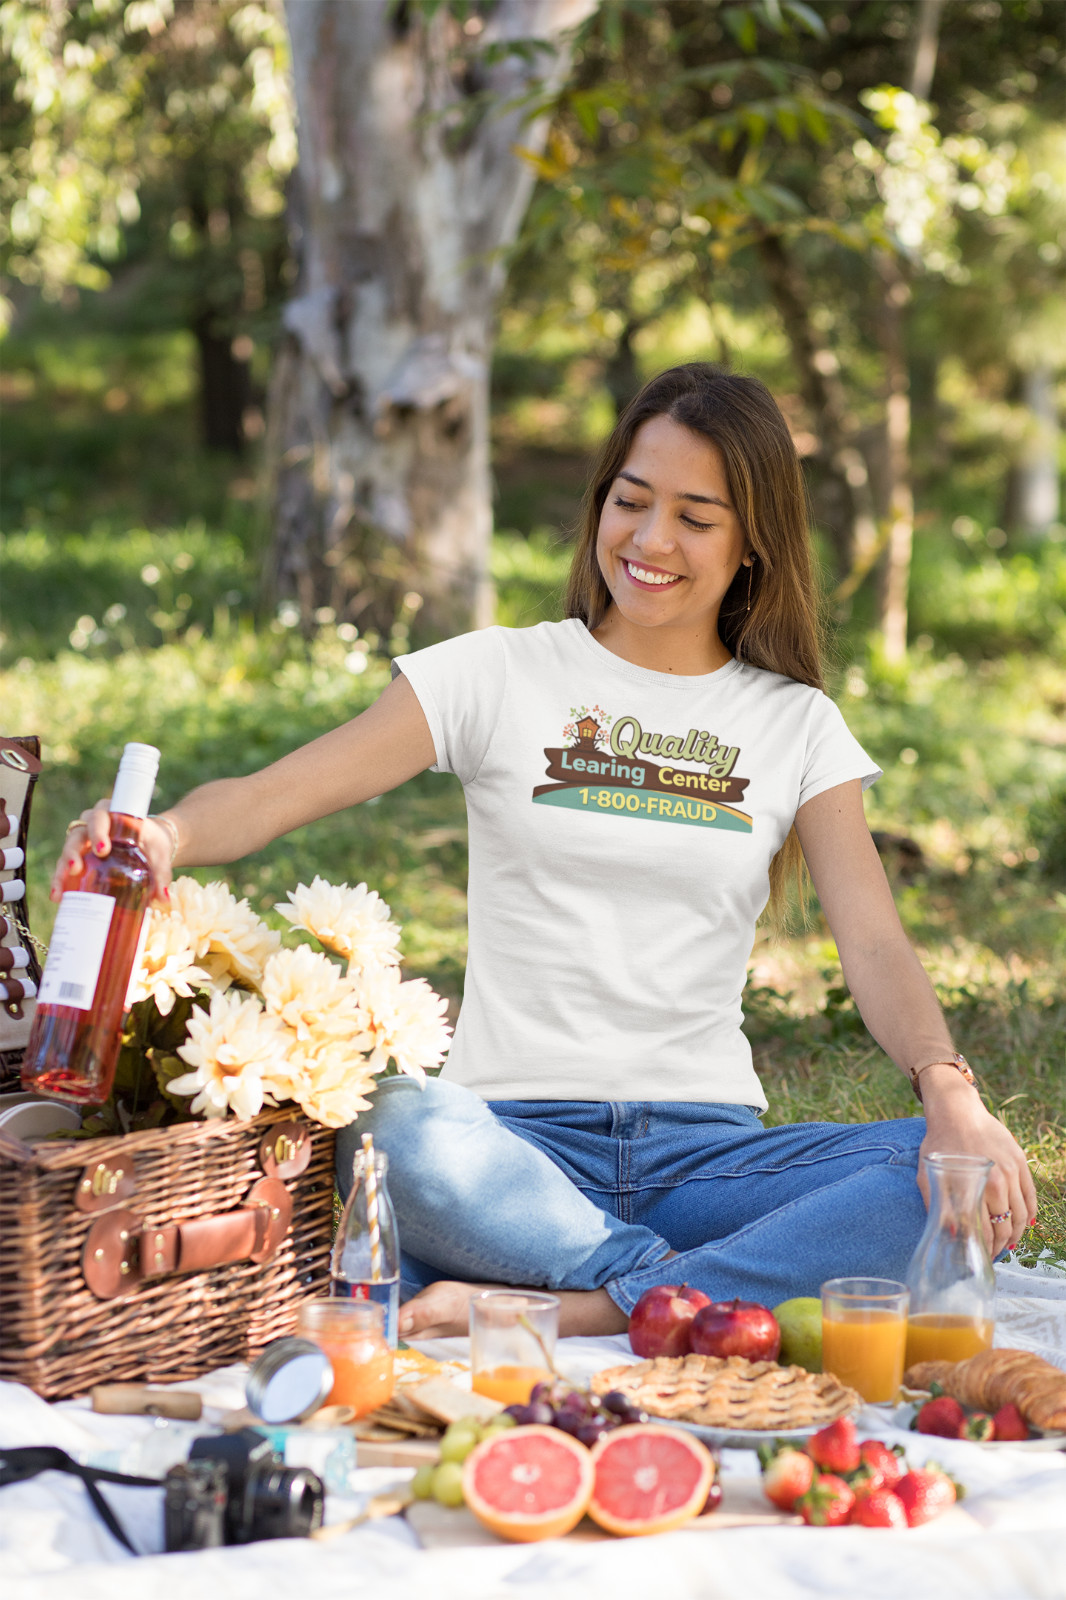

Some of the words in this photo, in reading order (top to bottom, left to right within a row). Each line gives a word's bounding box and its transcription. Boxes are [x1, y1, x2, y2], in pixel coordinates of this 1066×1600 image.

[610, 716, 741, 778] Quality
[561, 751, 645, 786] Learing
[658, 767, 732, 793] Center
[578, 788, 717, 822] 1-800-FRAUD
